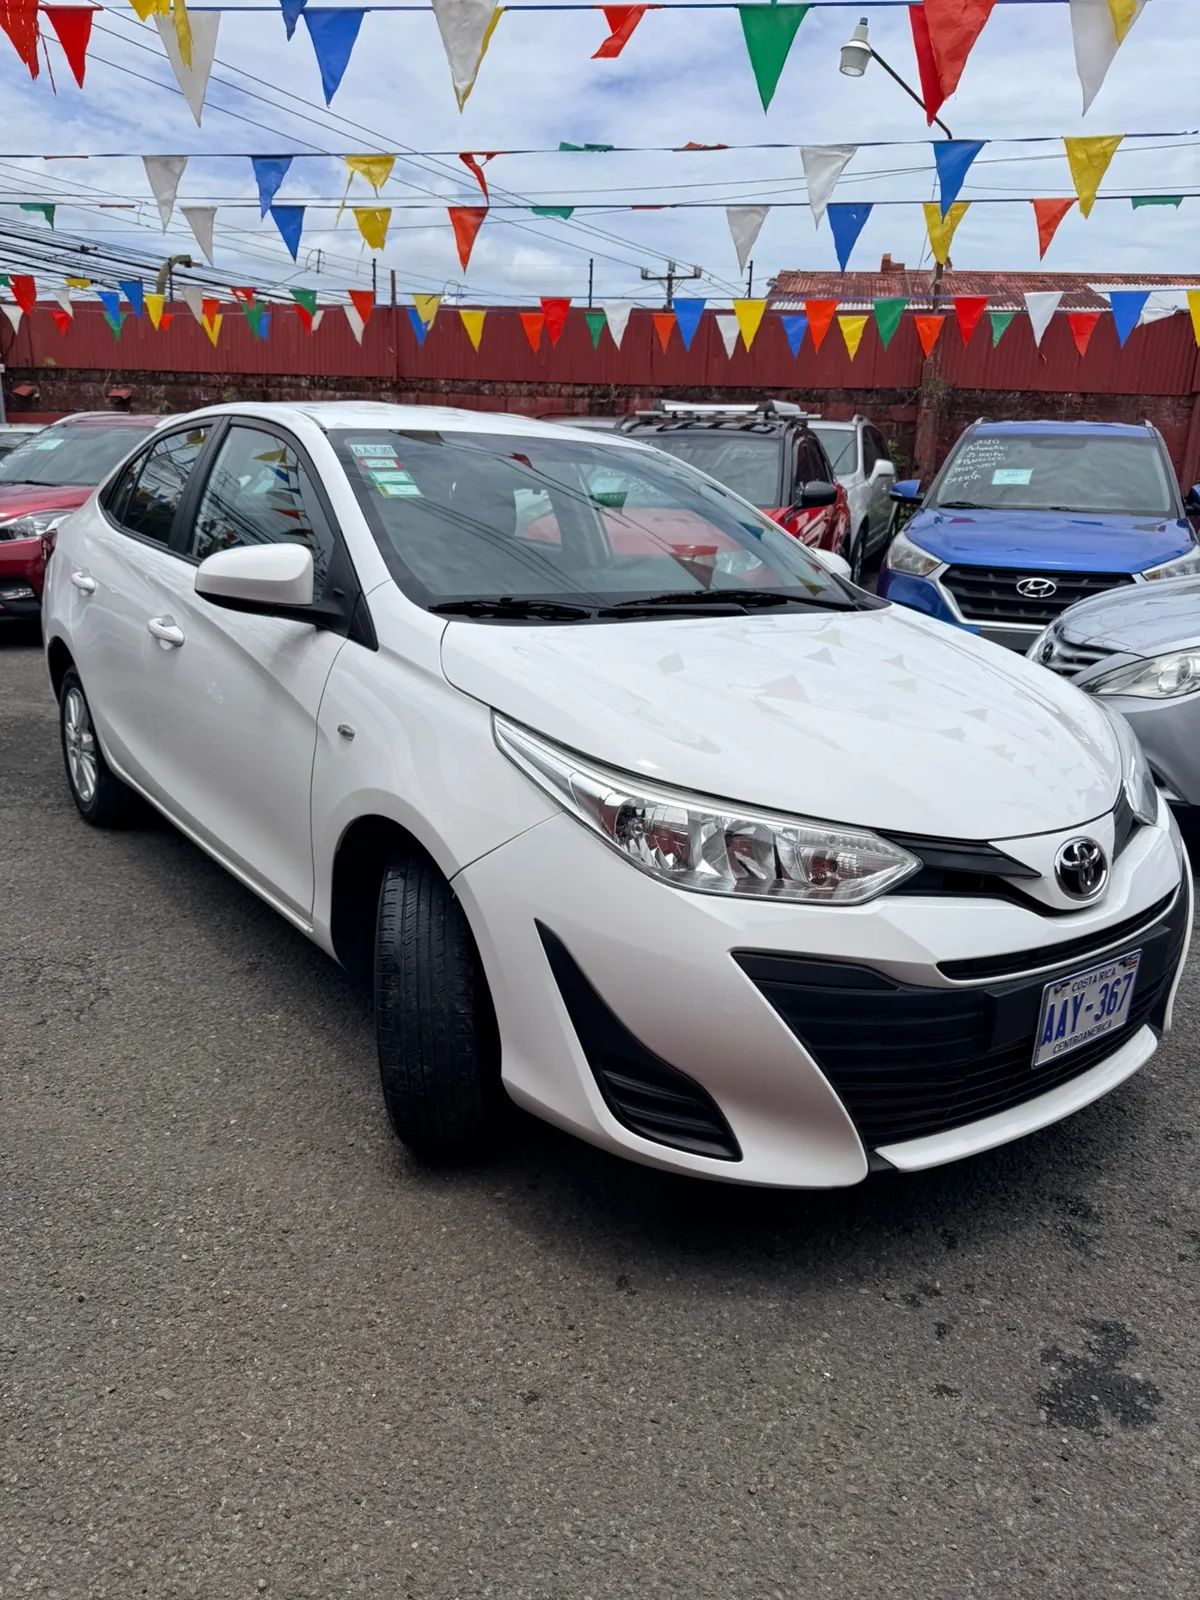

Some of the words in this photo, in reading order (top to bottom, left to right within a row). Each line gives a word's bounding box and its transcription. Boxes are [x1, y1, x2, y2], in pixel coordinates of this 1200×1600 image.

[1072, 975, 1097, 992] COSTA
[1099, 967, 1116, 981] RICA
[1041, 971, 1135, 1045] AAY-367
[1053, 1019, 1113, 1054] CENTROAMERICA
